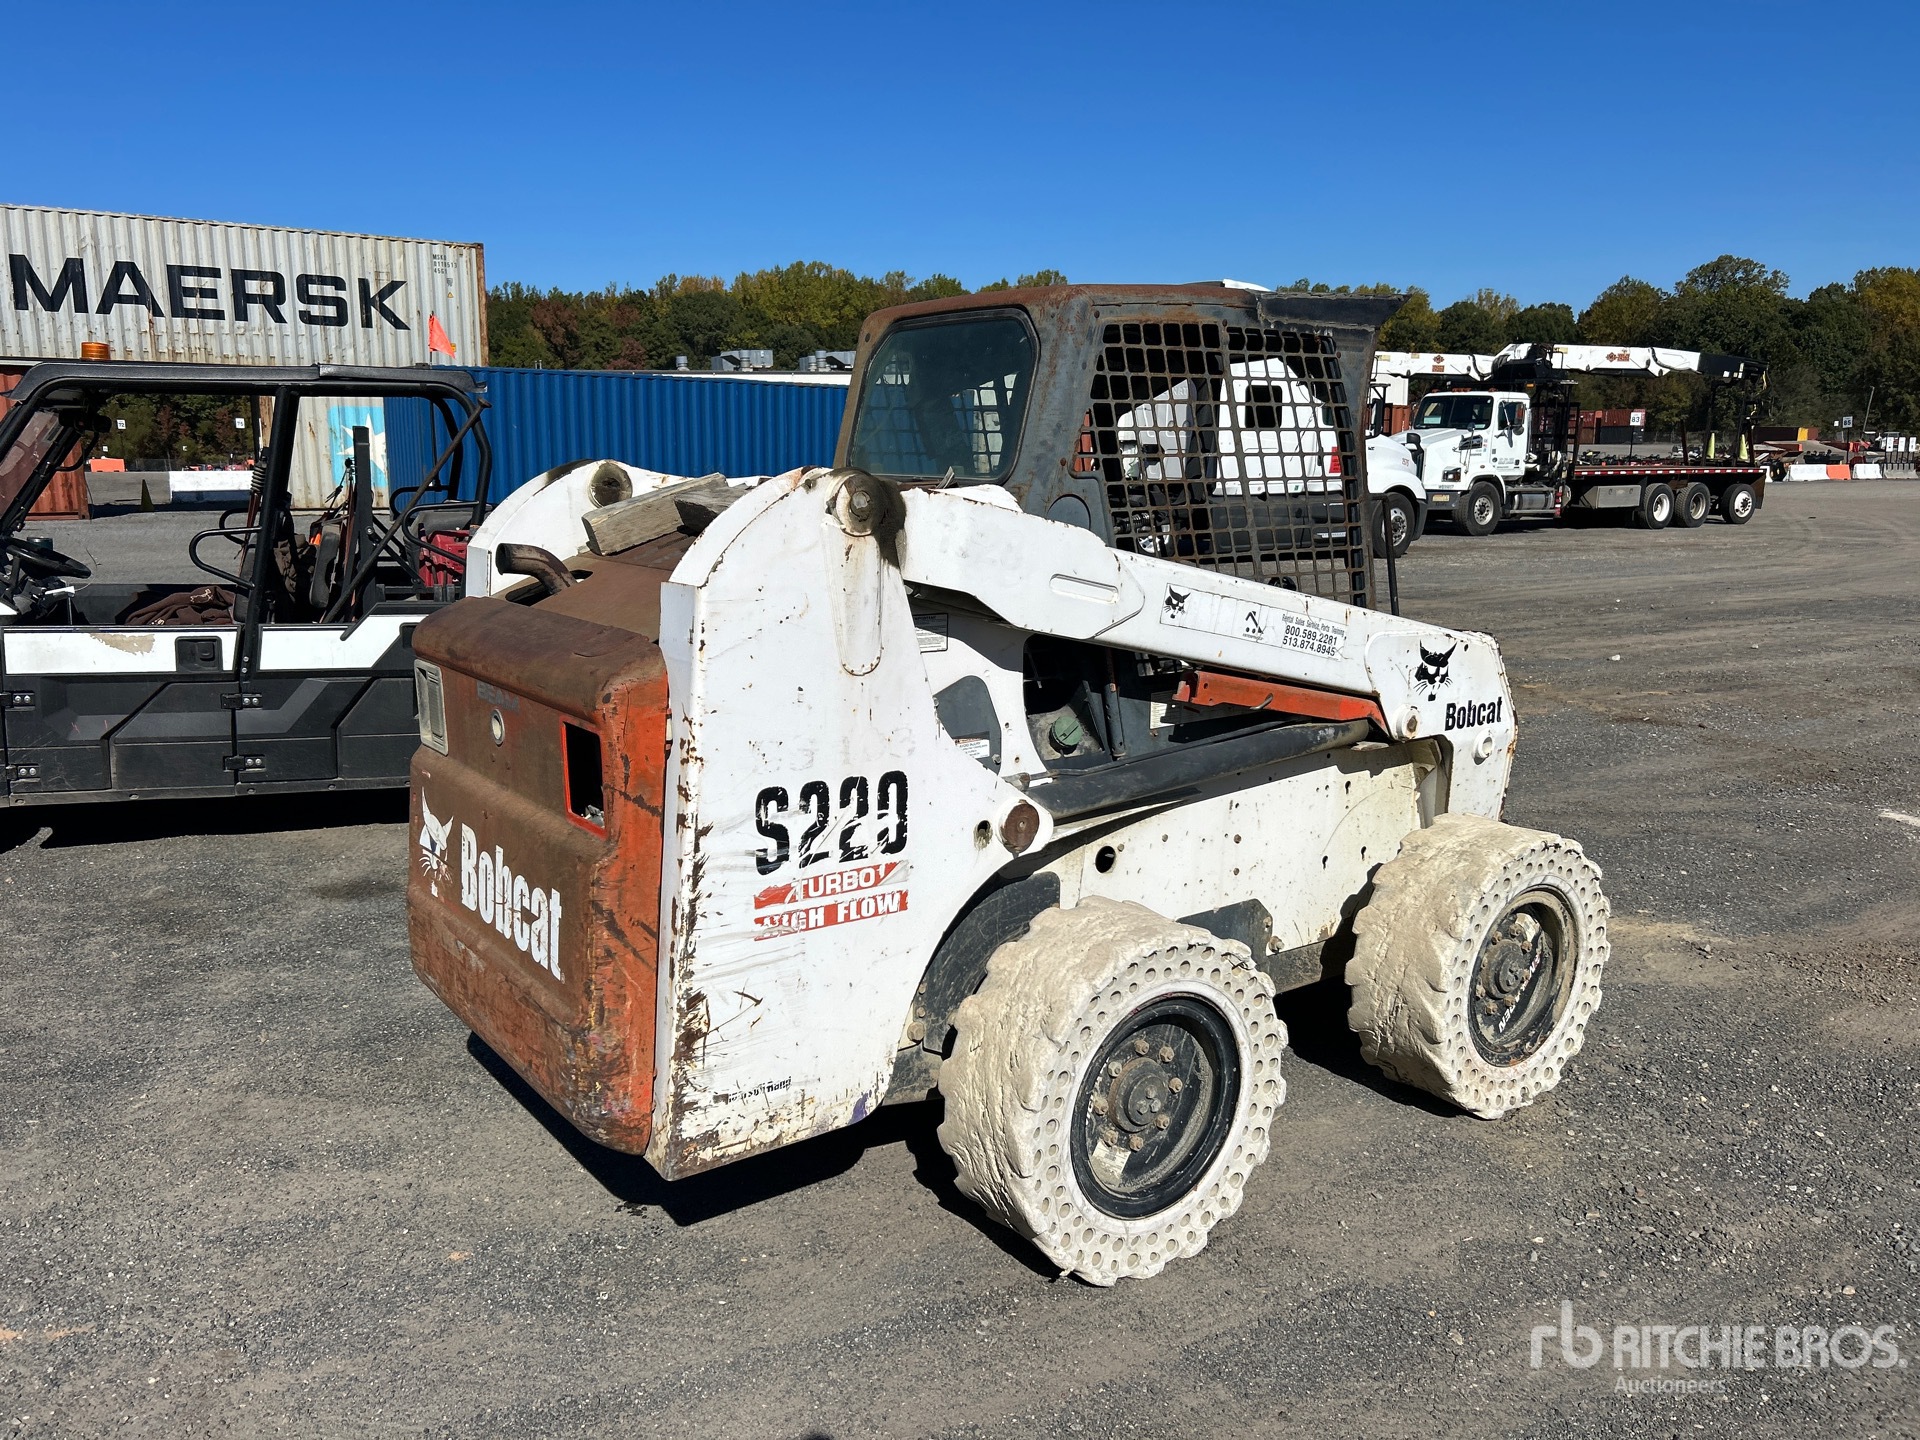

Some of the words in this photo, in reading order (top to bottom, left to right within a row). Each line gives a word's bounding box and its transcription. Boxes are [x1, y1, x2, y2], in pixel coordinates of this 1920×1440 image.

[8, 253, 411, 330] MAERSK
[1282, 635, 1336, 657] 513.874.8945
[1284, 624, 1338, 646] 800.589.2281
[1444, 696, 1503, 731] Bobcat
[755, 769, 909, 876] S220
[791, 866, 875, 901] TURBO
[461, 822, 562, 982] Bobcat
[836, 894, 901, 922] FLOW
